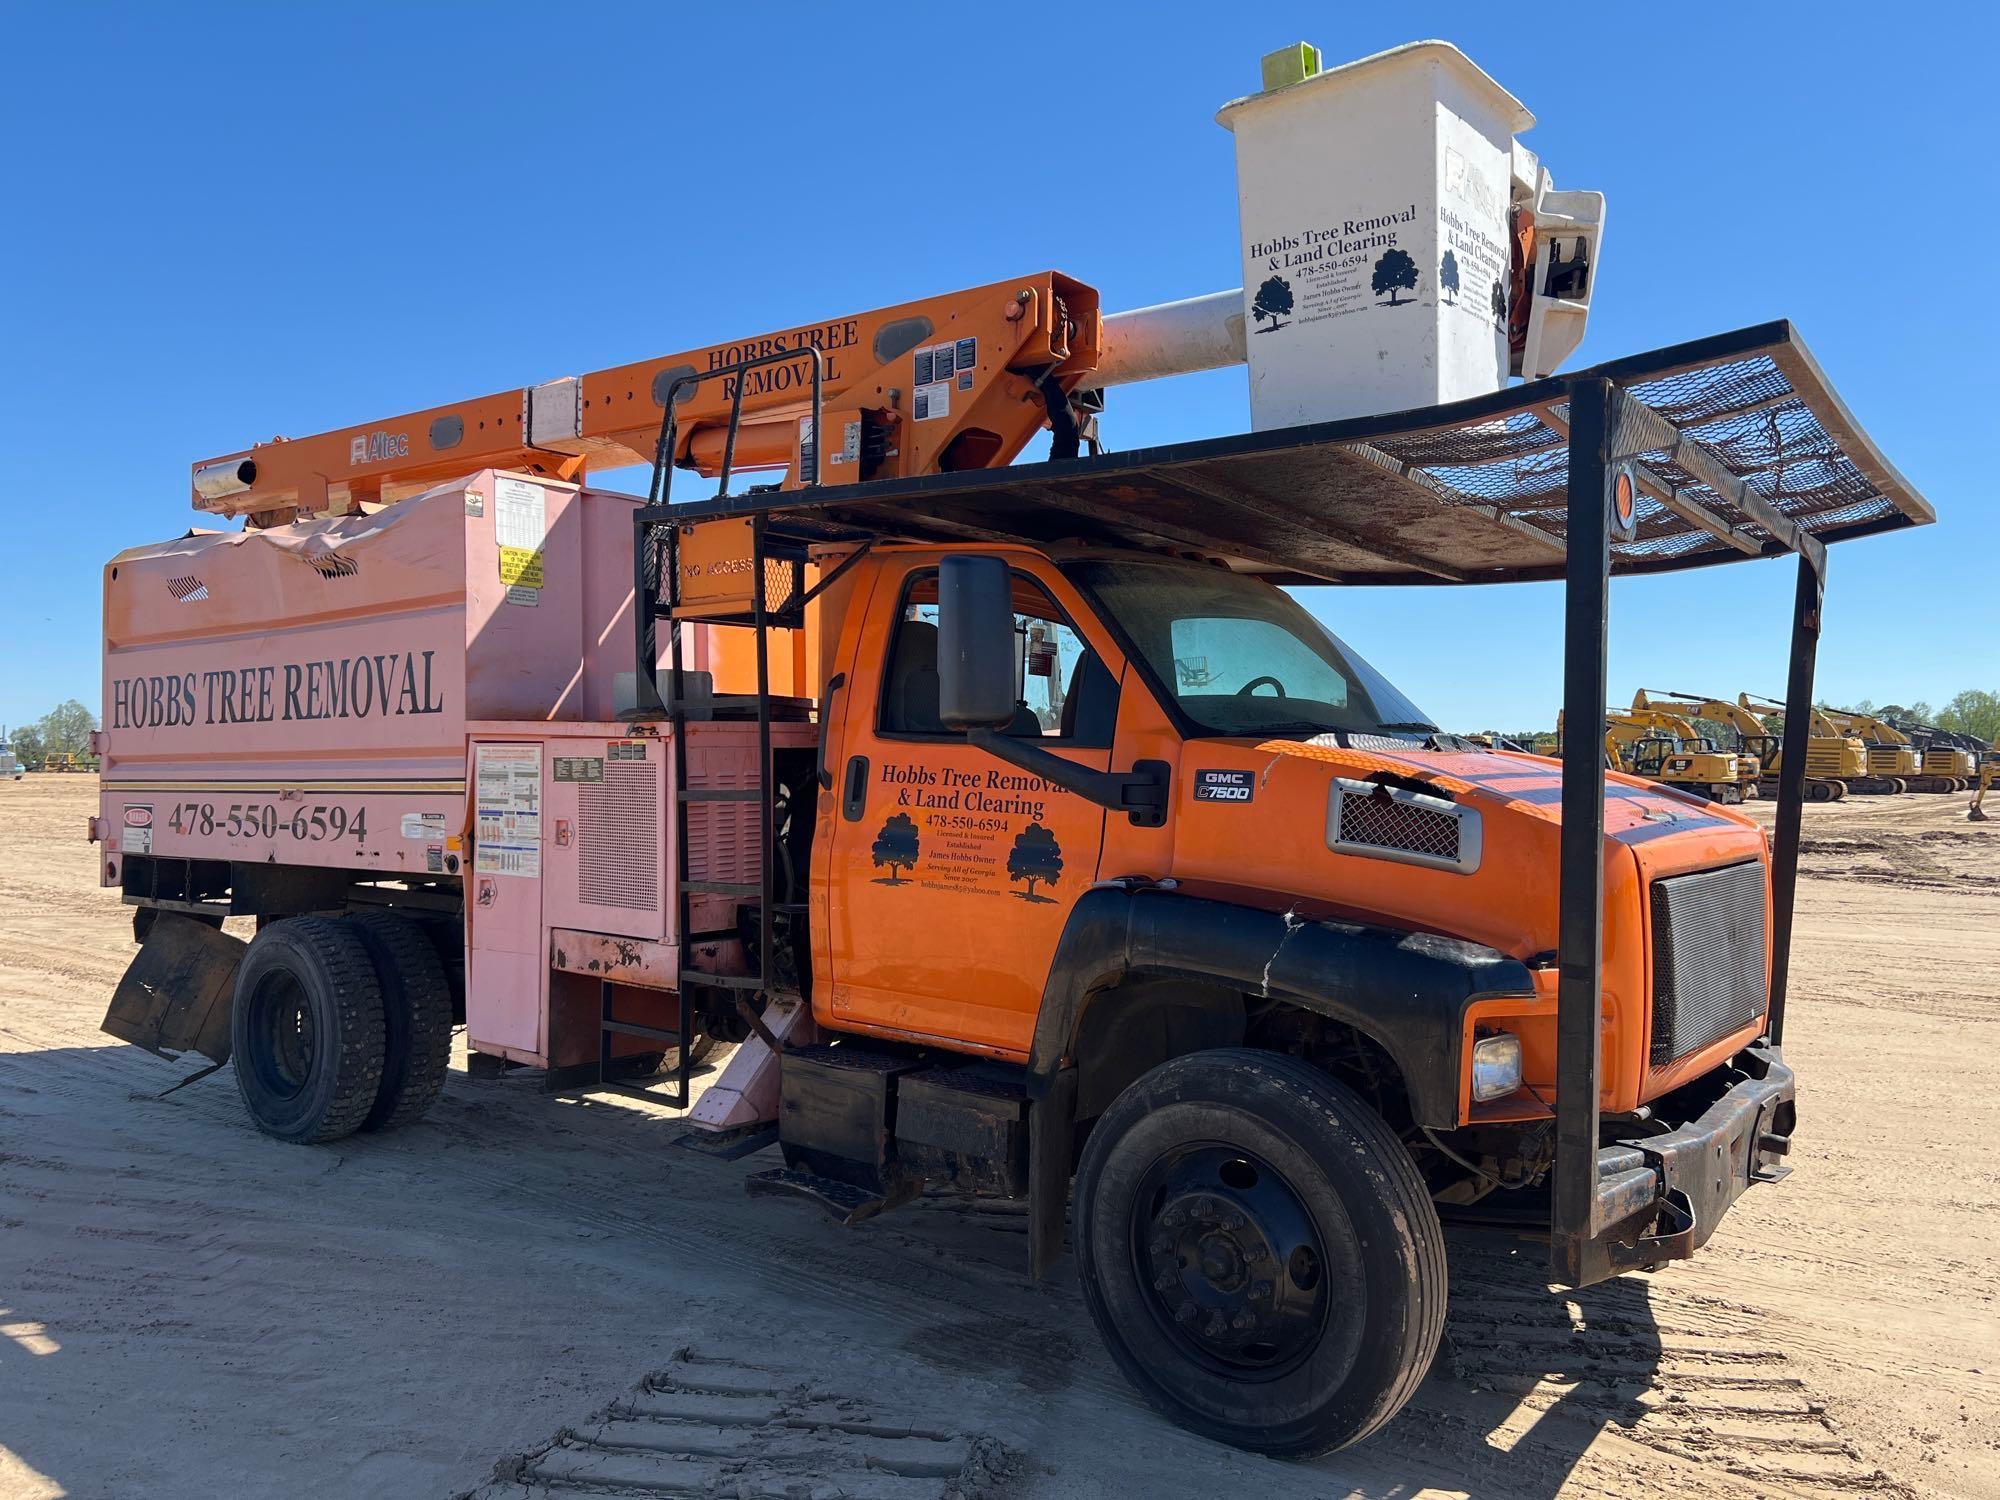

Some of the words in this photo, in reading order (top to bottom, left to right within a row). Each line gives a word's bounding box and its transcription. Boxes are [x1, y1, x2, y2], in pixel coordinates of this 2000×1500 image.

[1250, 237, 1299, 259] Hobbs
[1303, 227, 1339, 246] Tree
[1343, 205, 1417, 236] Removal
[1440, 206, 1463, 233] Hobbs
[1464, 220, 1480, 243] Tree
[1481, 232, 1507, 261] Removal
[1269, 256, 1280, 271] &
[1284, 245, 1323, 268] Land
[1327, 232, 1397, 257] Clearing
[1447, 229, 1454, 246] &
[1455, 233, 1474, 256] Land
[1474, 245, 1500, 277] Clearing
[1295, 254, 1369, 279] 478-550-6594
[1302, 291, 1321, 301] James
[1322, 287, 1341, 298] Hobbs
[1316, 277, 1348, 289] Established
[708, 336, 786, 371] HOBBS
[793, 320, 859, 351] TREE
[723, 356, 841, 401] REMOVL
[368, 431, 409, 462] Altec
[685, 564, 701, 577] NO
[707, 557, 754, 576] ACCESS
[113, 672, 197, 729] HOBBS
[203, 666, 275, 725] TREE
[282, 650, 443, 721] REMOVAL
[881, 764, 937, 786] Hobbs
[941, 767, 981, 788] Tree
[986, 770, 1069, 794] Remova
[1205, 773, 1244, 784] GMC
[1197, 785, 1250, 799] C7500
[897, 788, 911, 806] &
[915, 790, 960, 811] Land
[964, 792, 1045, 822] Clearing
[168, 802, 368, 843] 478-550-6594
[925, 815, 1009, 833] 478-550-6594
[936, 829, 963, 839] Licensed
[970, 833, 995, 841] Insured
[929, 850, 950, 860] James
[950, 852, 972, 862] Hobbs
[973, 855, 997, 865] Owner
[946, 841, 982, 851] Established
[926, 862, 952, 873] Serving
[962, 867, 970, 875] of
[969, 868, 996, 878] Georgia
[943, 873, 961, 882] Since
